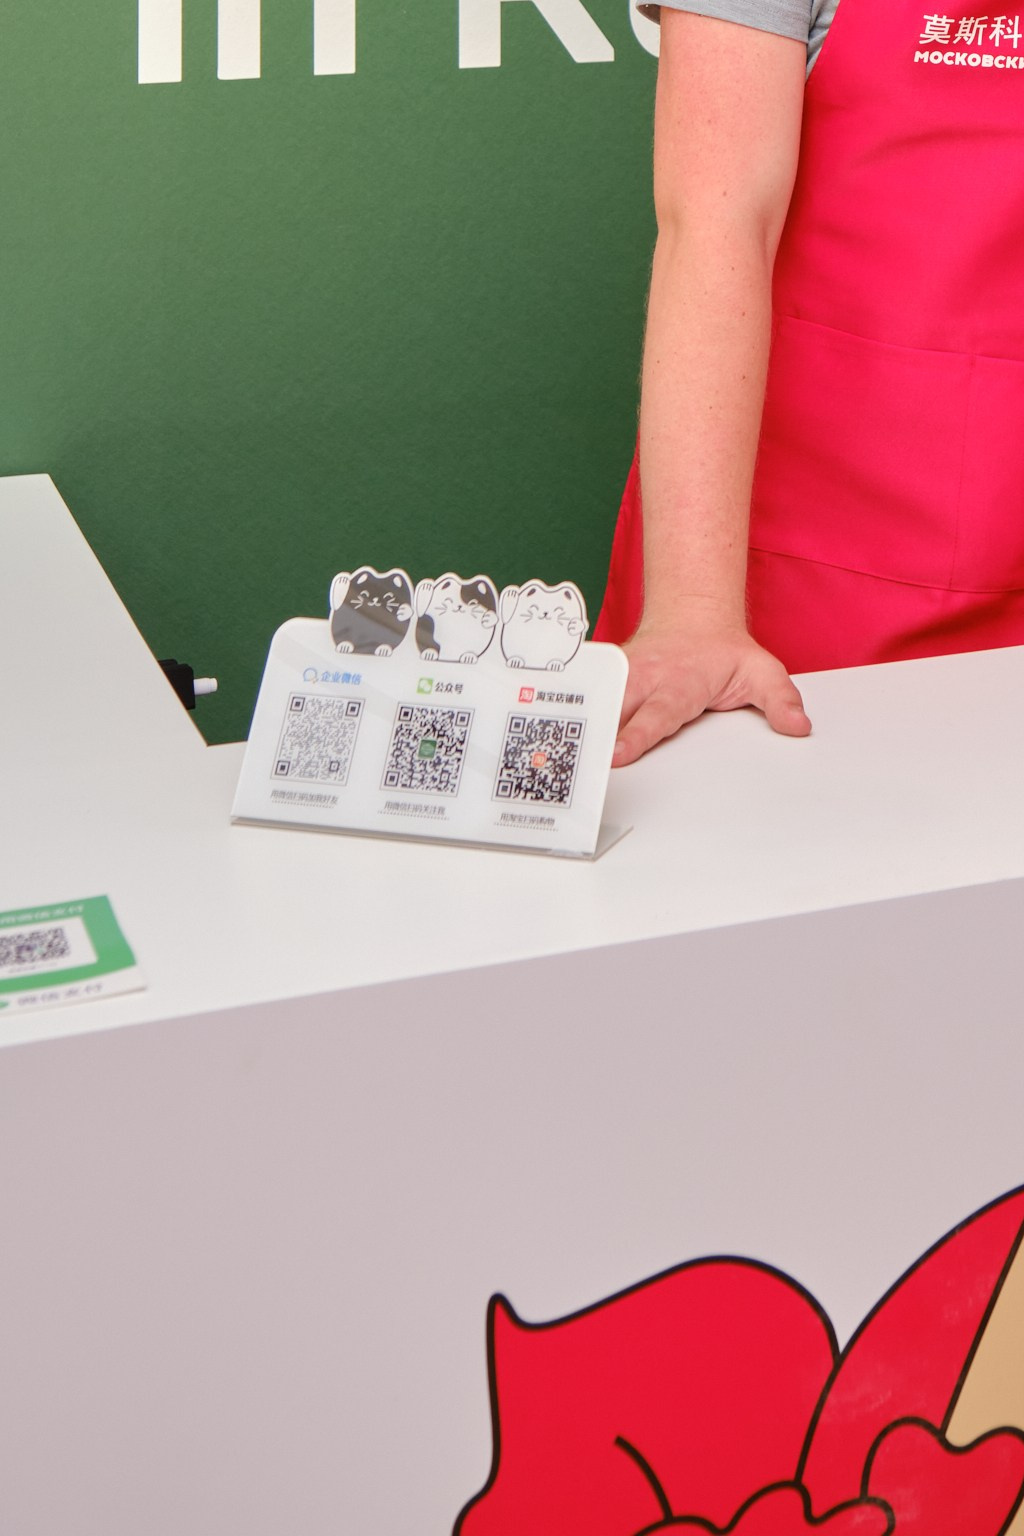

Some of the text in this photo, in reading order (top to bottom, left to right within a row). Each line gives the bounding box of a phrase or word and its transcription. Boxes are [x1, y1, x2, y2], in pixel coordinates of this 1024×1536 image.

[321, 671, 362, 686] 企业微信
[435, 682, 464, 695] 公众号
[535, 691, 584, 705] 淘宝店铺码
